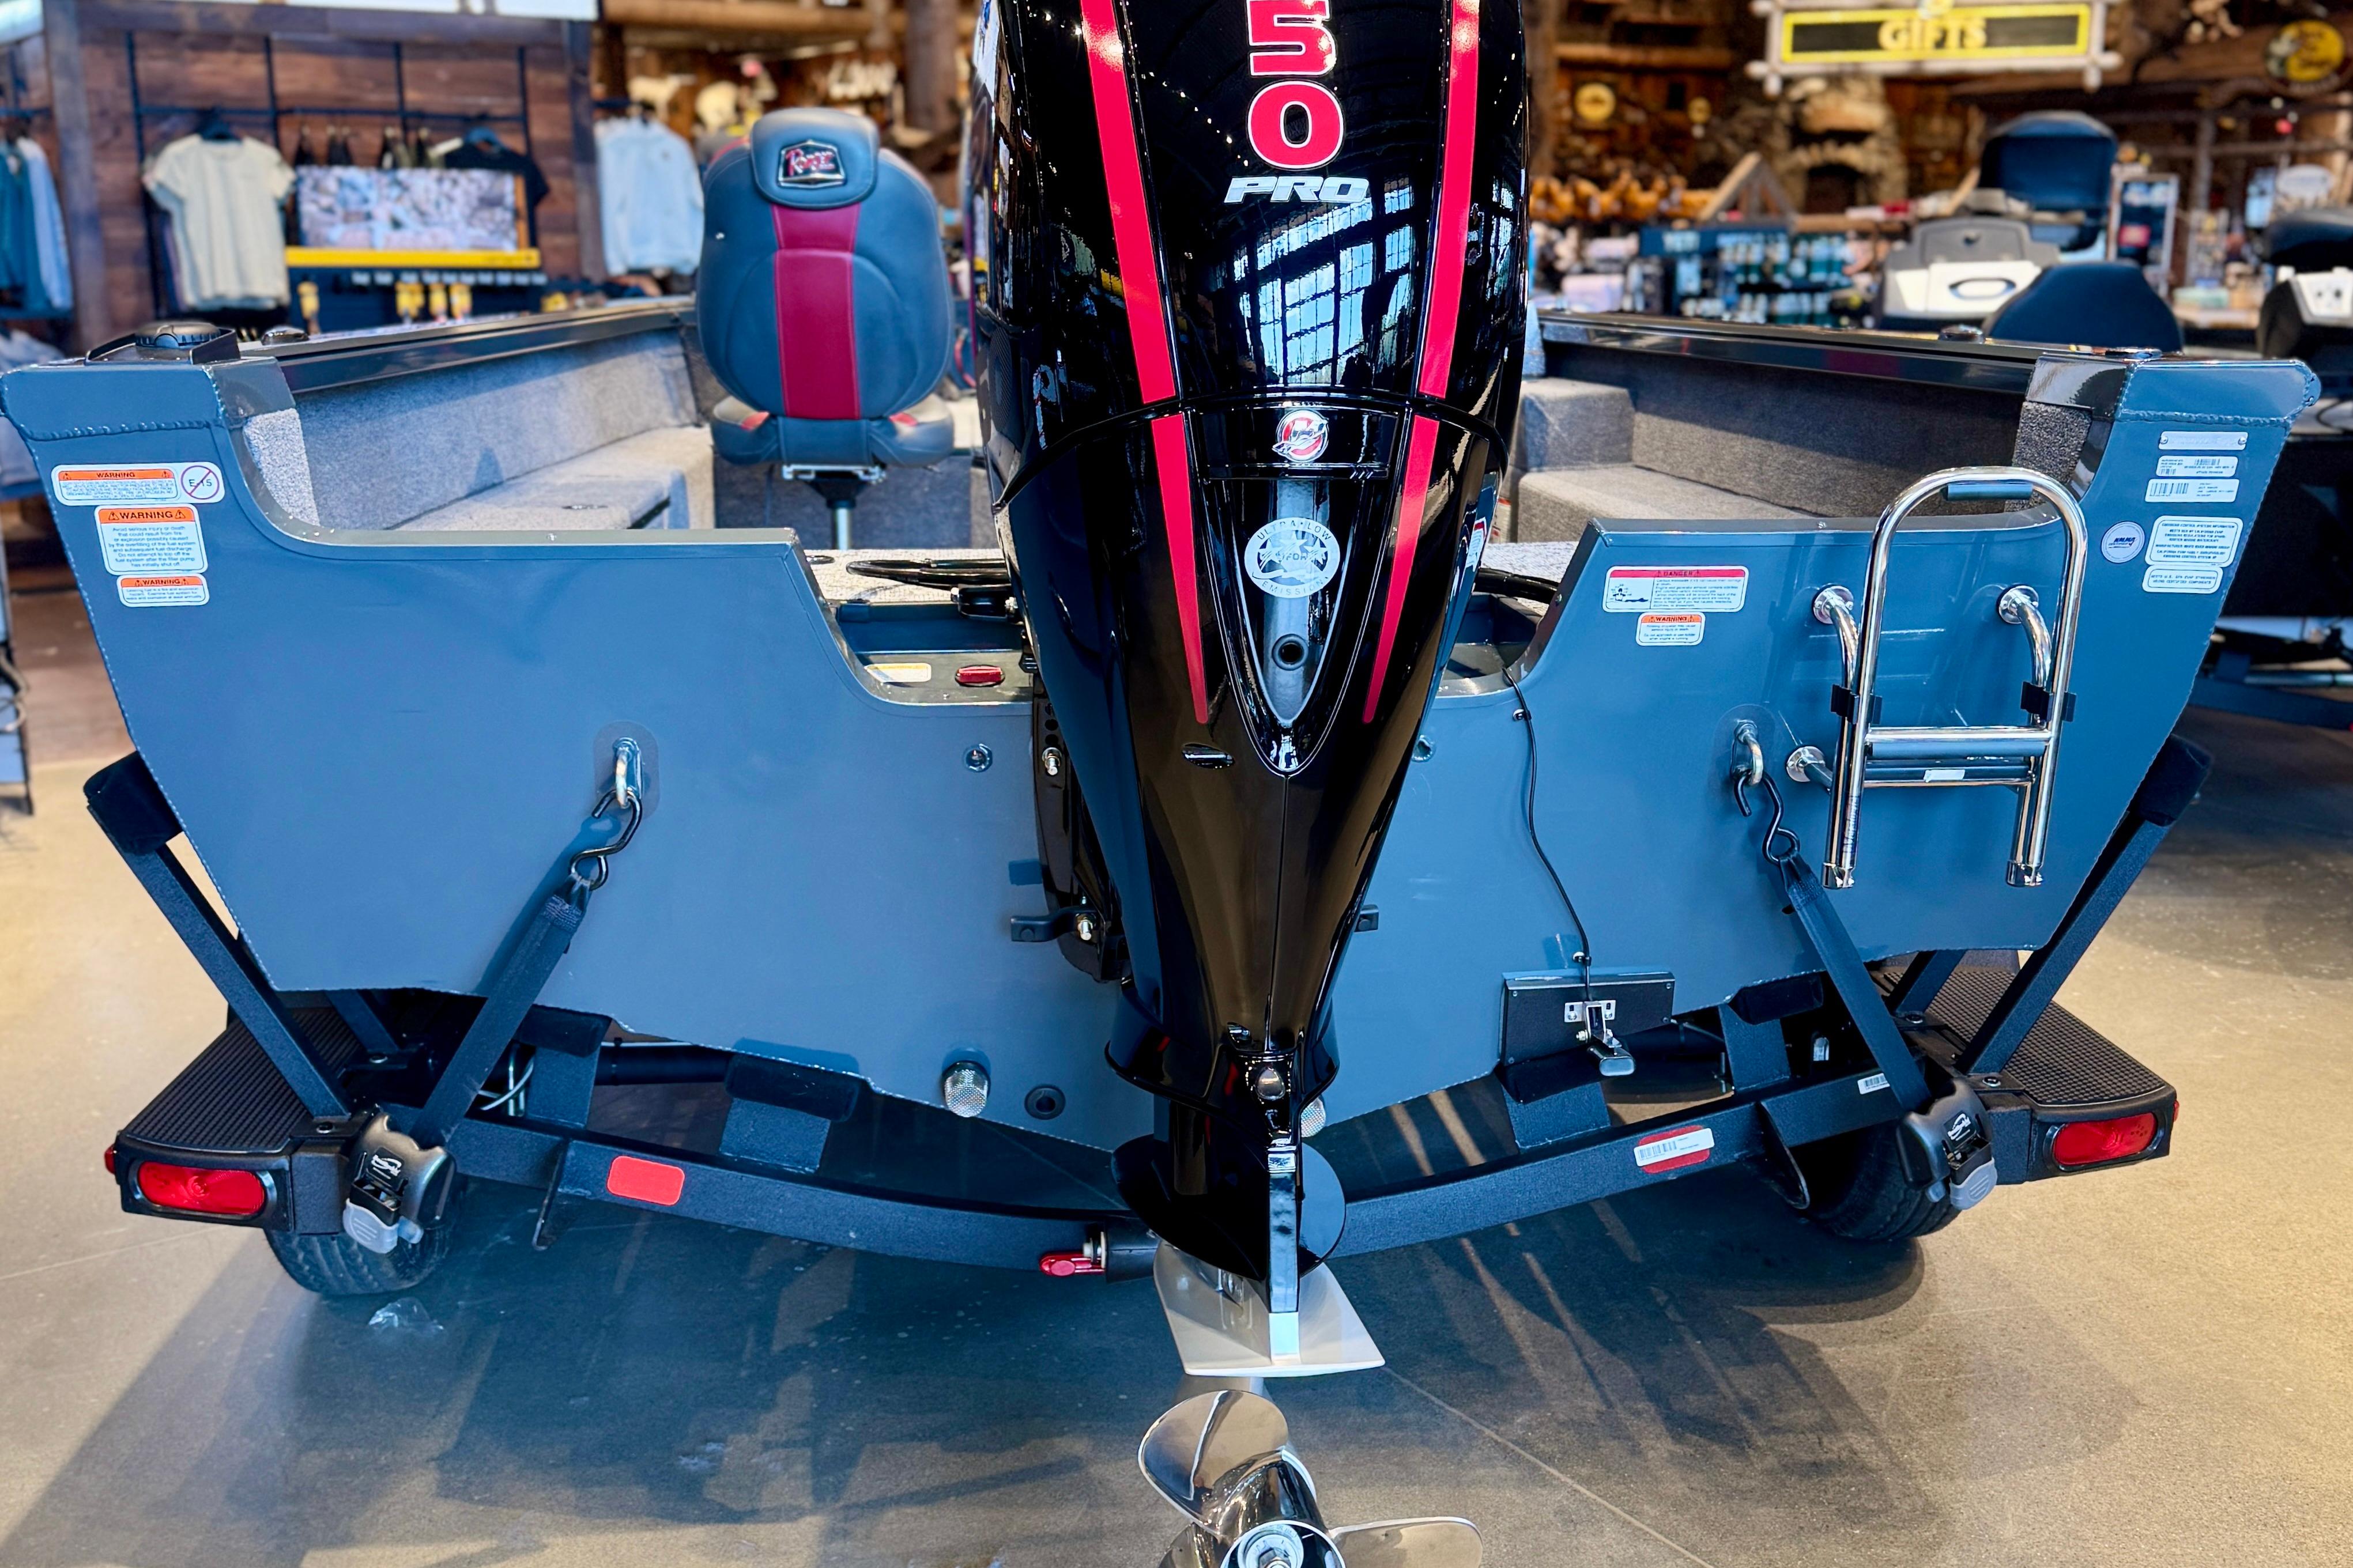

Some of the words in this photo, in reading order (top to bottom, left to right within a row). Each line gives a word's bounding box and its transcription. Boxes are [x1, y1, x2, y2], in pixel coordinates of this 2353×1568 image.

[1878, 18, 1987, 51] GIFTS
[1224, 176, 1370, 203] PRO
[119, 511, 173, 519] WARNING
[1307, 522, 1332, 540] LOW
